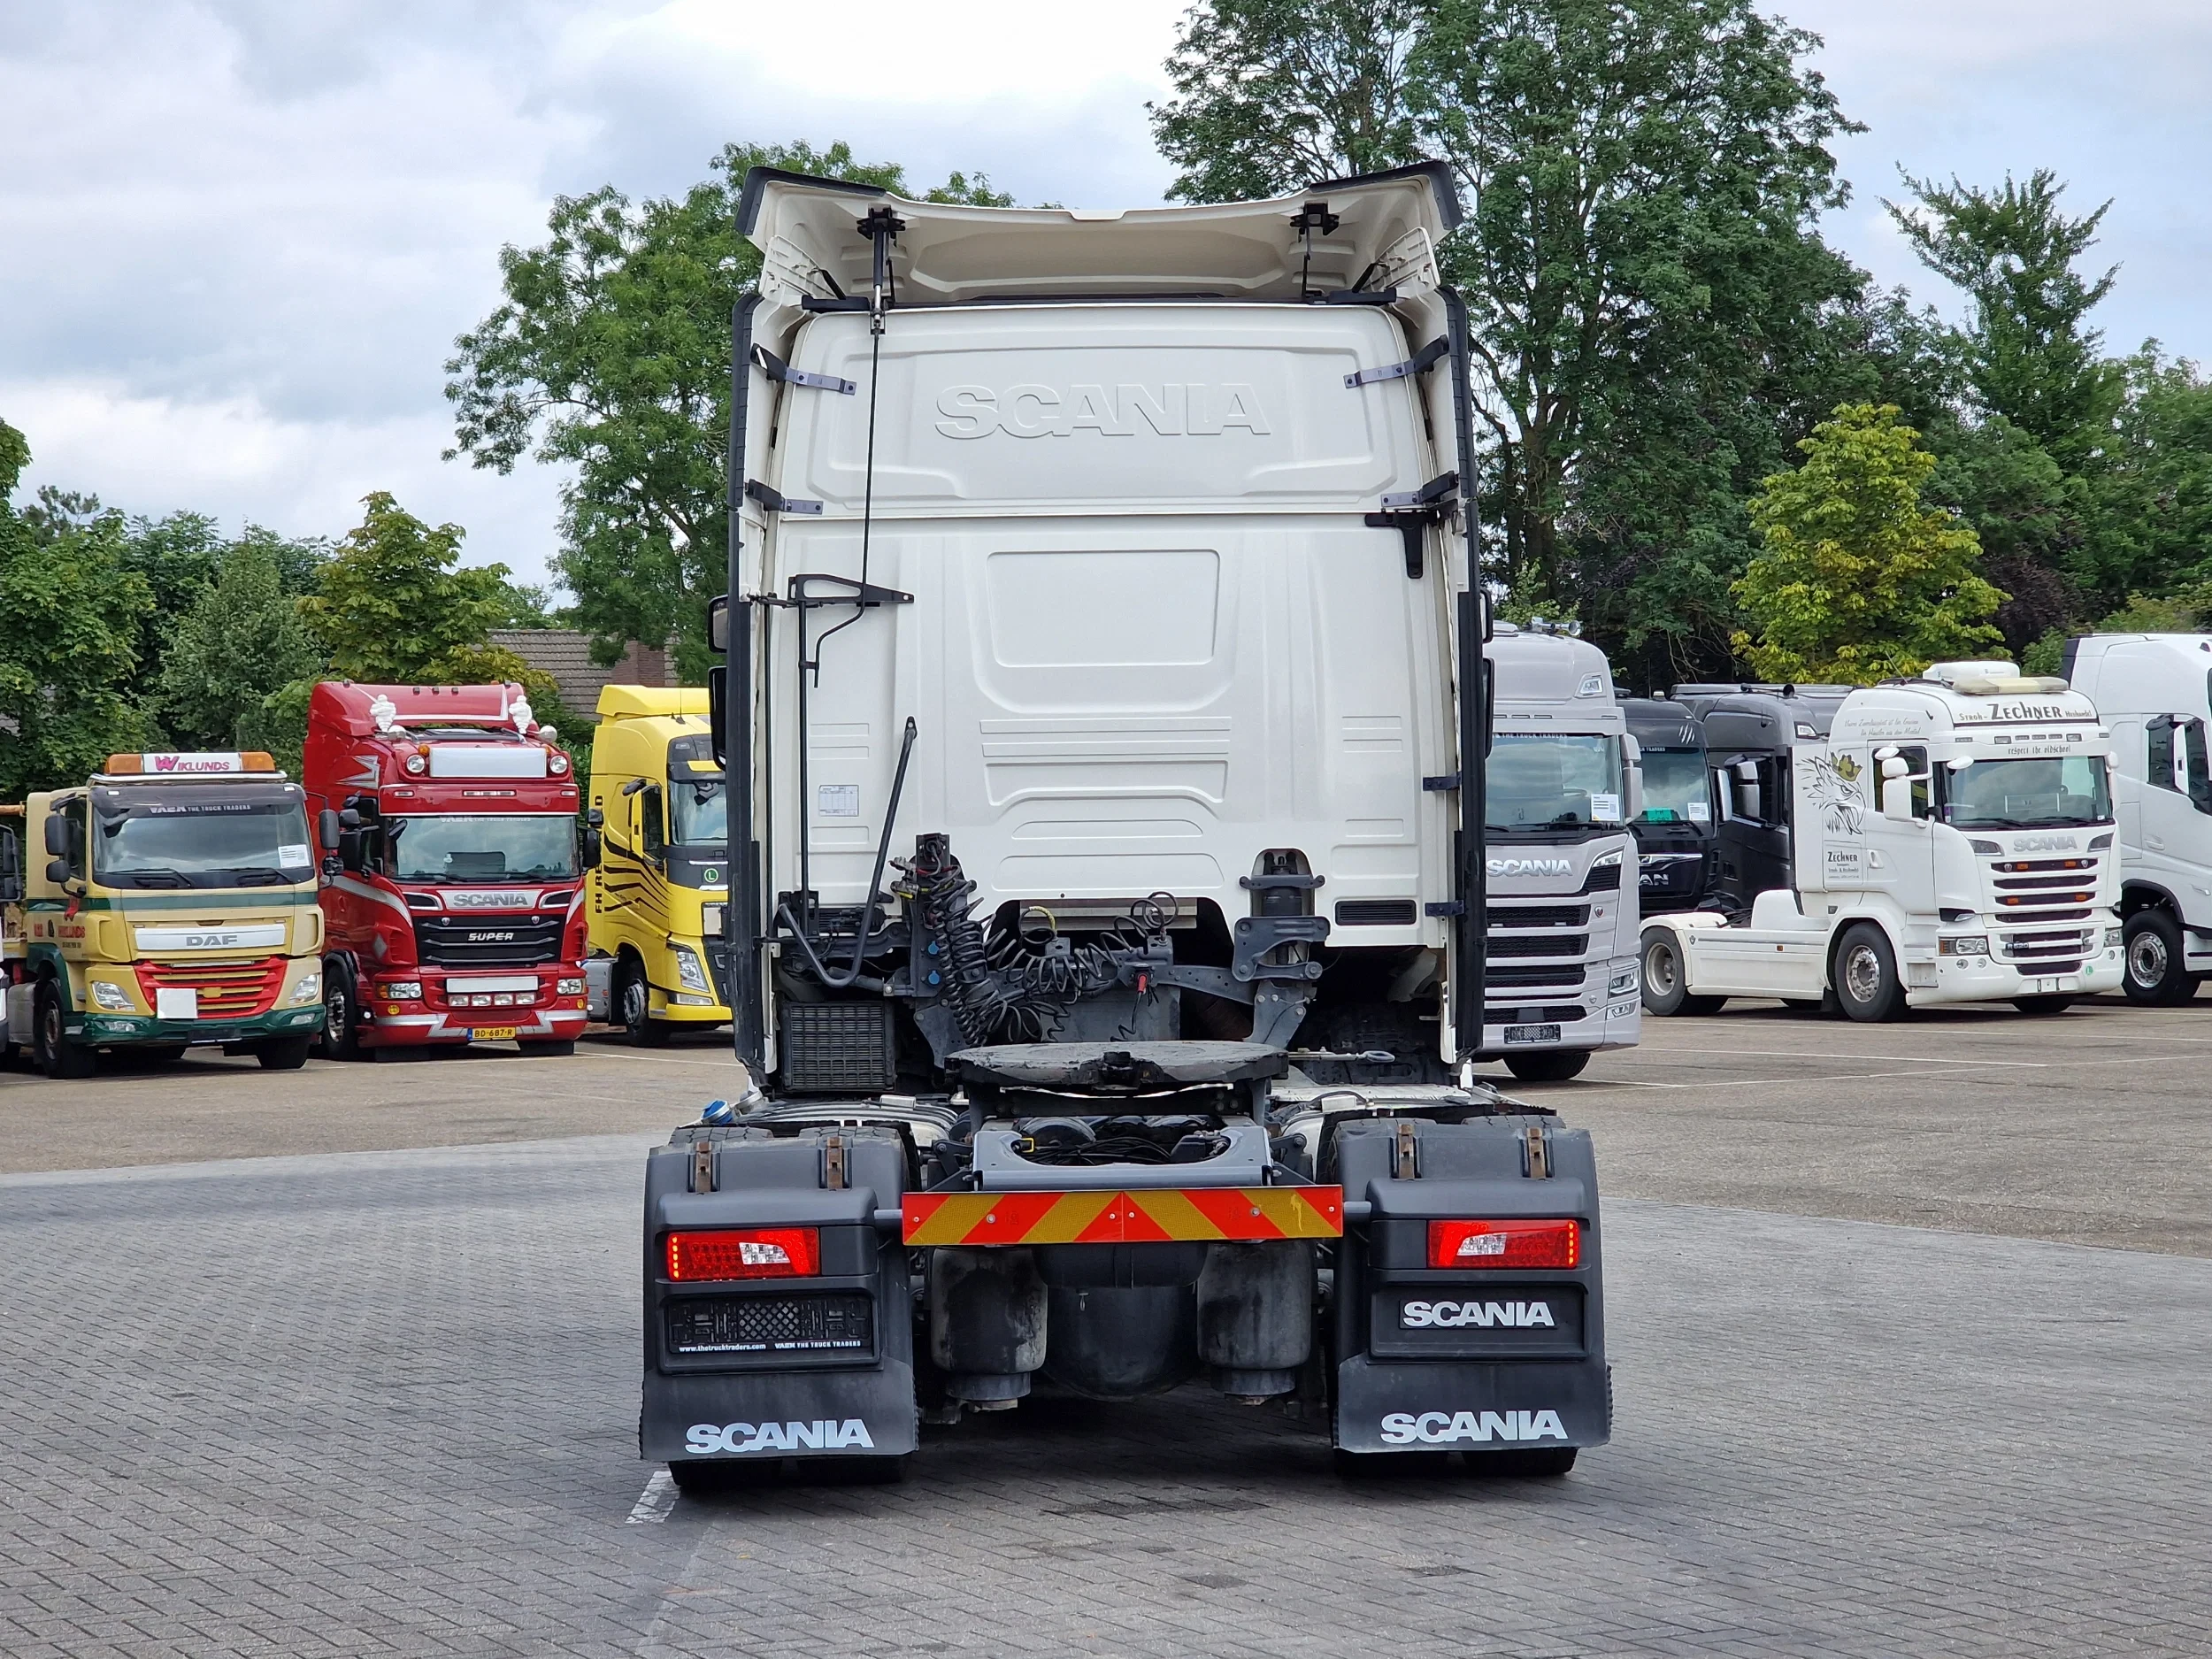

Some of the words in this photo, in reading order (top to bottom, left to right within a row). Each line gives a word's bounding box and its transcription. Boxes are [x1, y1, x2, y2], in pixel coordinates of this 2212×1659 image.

[935, 383, 1271, 440] SCANIA
[154, 756, 230, 772] WIKLUNDS
[2014, 836, 2078, 852] SCANIA
[1486, 859, 1573, 877] SCANIA
[453, 894, 528, 907] SCANIA
[186, 935, 237, 946] DAF
[468, 933, 514, 941] SUPER
[1403, 1302, 1555, 1327] SCANIA
[1380, 1409, 1568, 1444] SCANIA
[685, 1418, 875, 1454] SCANIA
